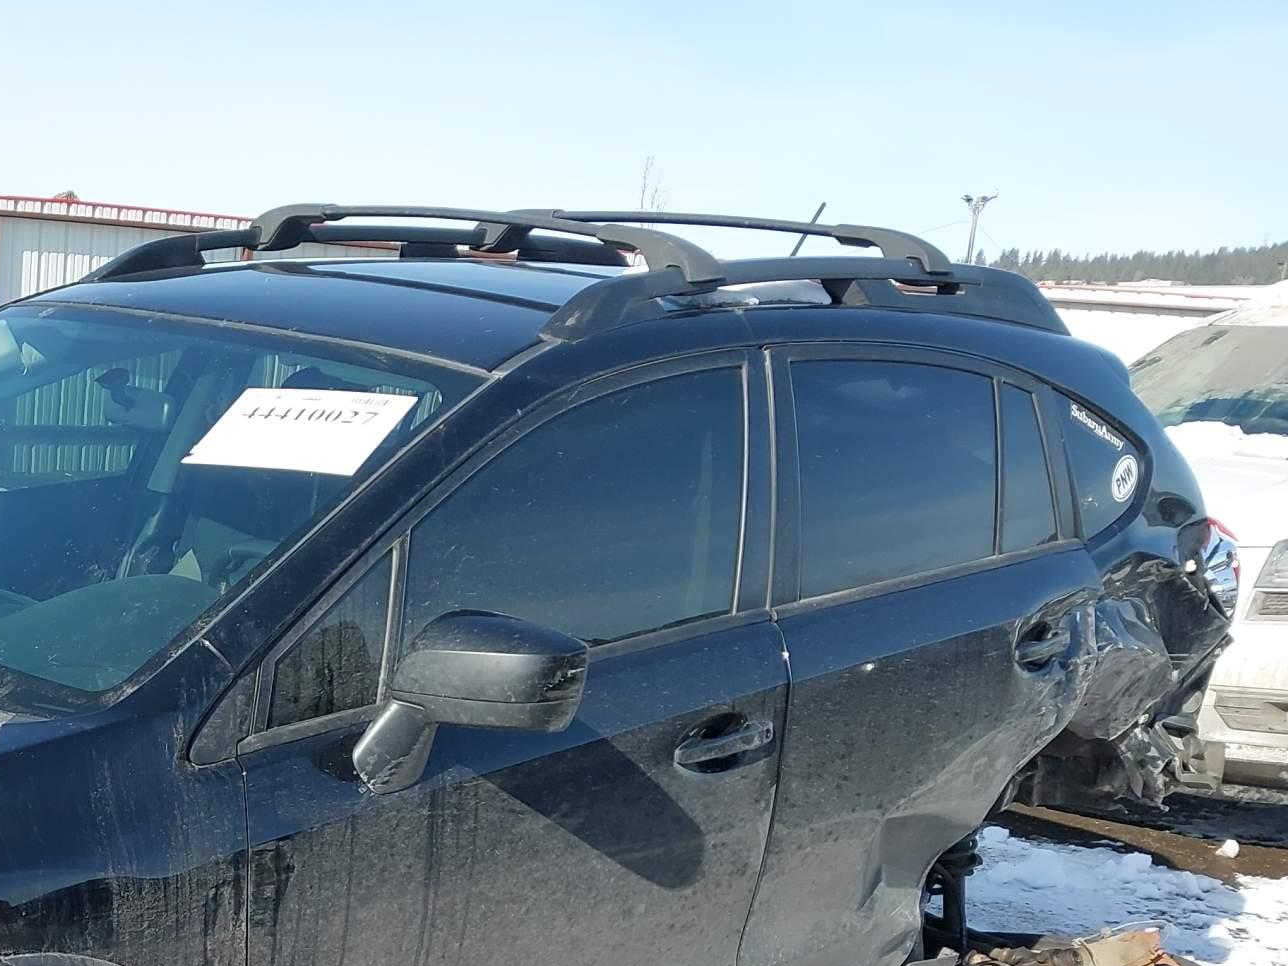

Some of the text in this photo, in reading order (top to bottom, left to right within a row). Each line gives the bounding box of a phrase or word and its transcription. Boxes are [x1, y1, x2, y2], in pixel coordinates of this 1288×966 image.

[242, 406, 380, 425] 44410027
[1071, 404, 1124, 451] SubaruArmy
[1116, 462, 1134, 494] PNW
